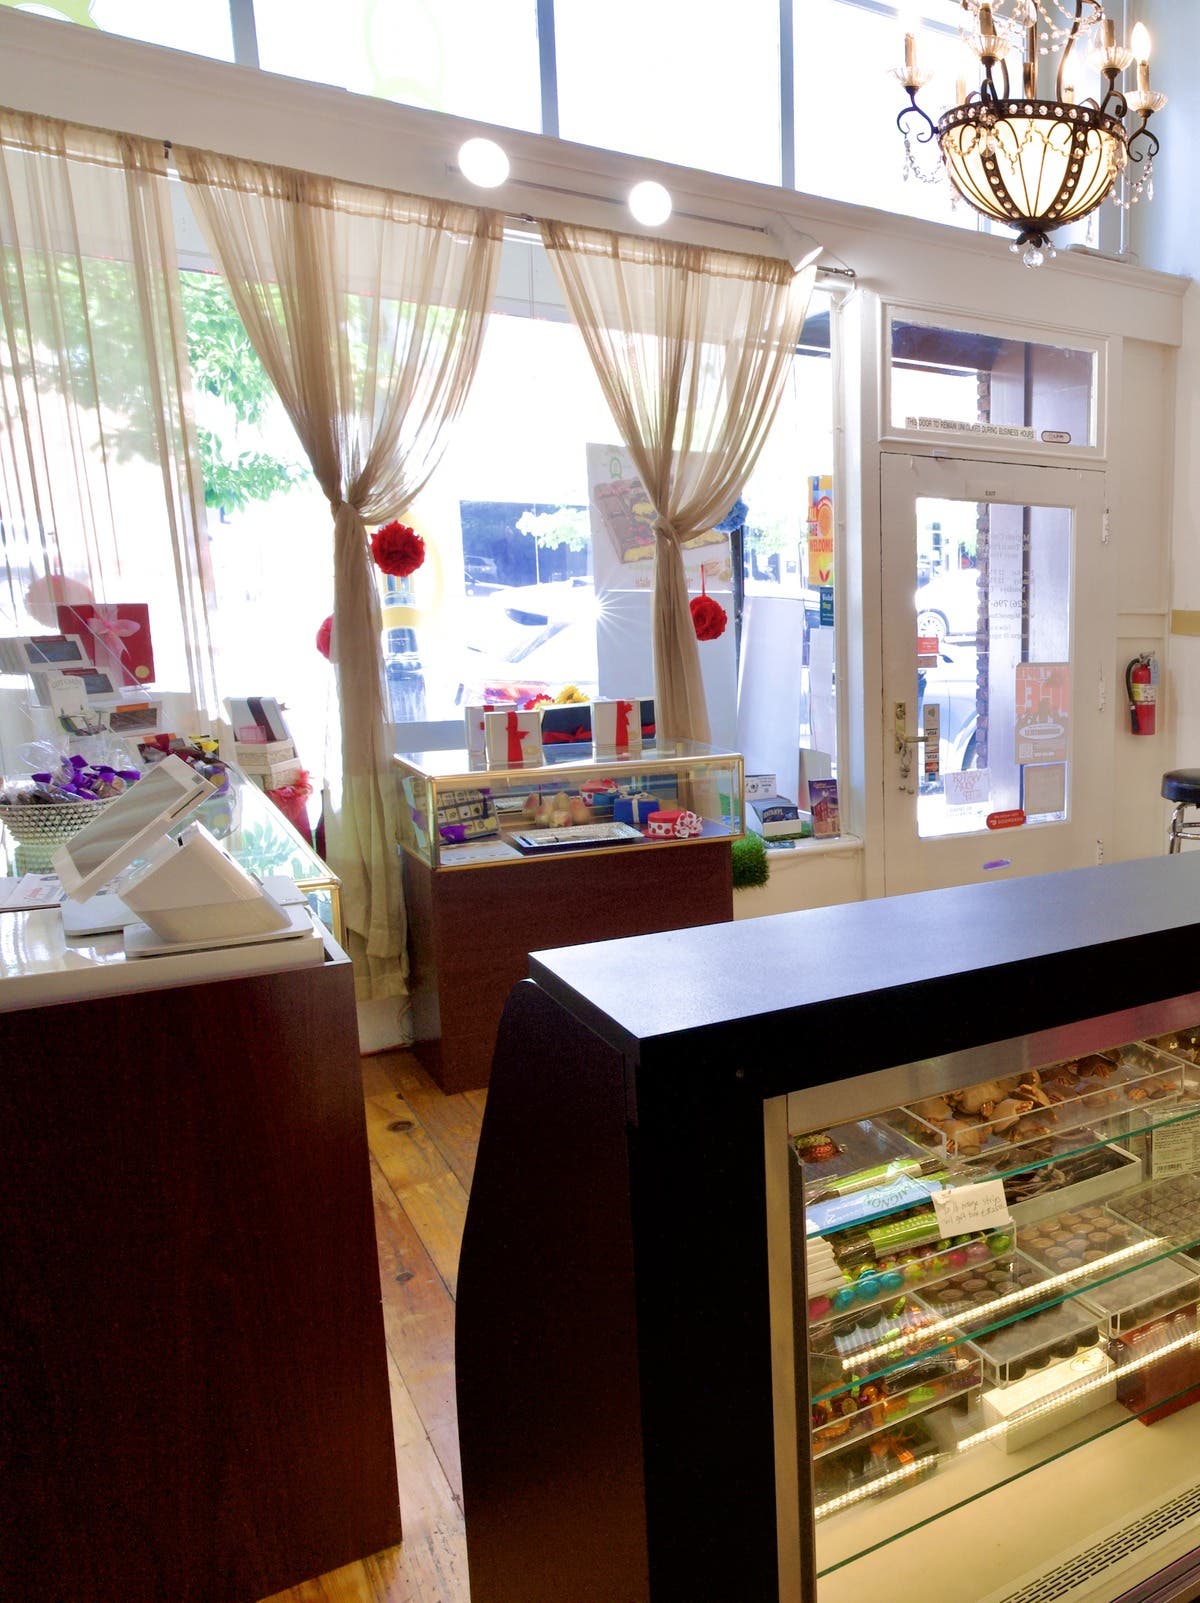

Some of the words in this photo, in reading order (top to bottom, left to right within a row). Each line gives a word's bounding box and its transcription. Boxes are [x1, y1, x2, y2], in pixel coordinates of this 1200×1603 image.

[919, 417, 932, 428] DOOR
[940, 420, 957, 430] REMAIN
[981, 425, 997, 434] DURING
[999, 426, 1019, 436] BUSINESS
[1020, 429, 1034, 438] HOURS
[809, 538, 833, 553] WELCOME
